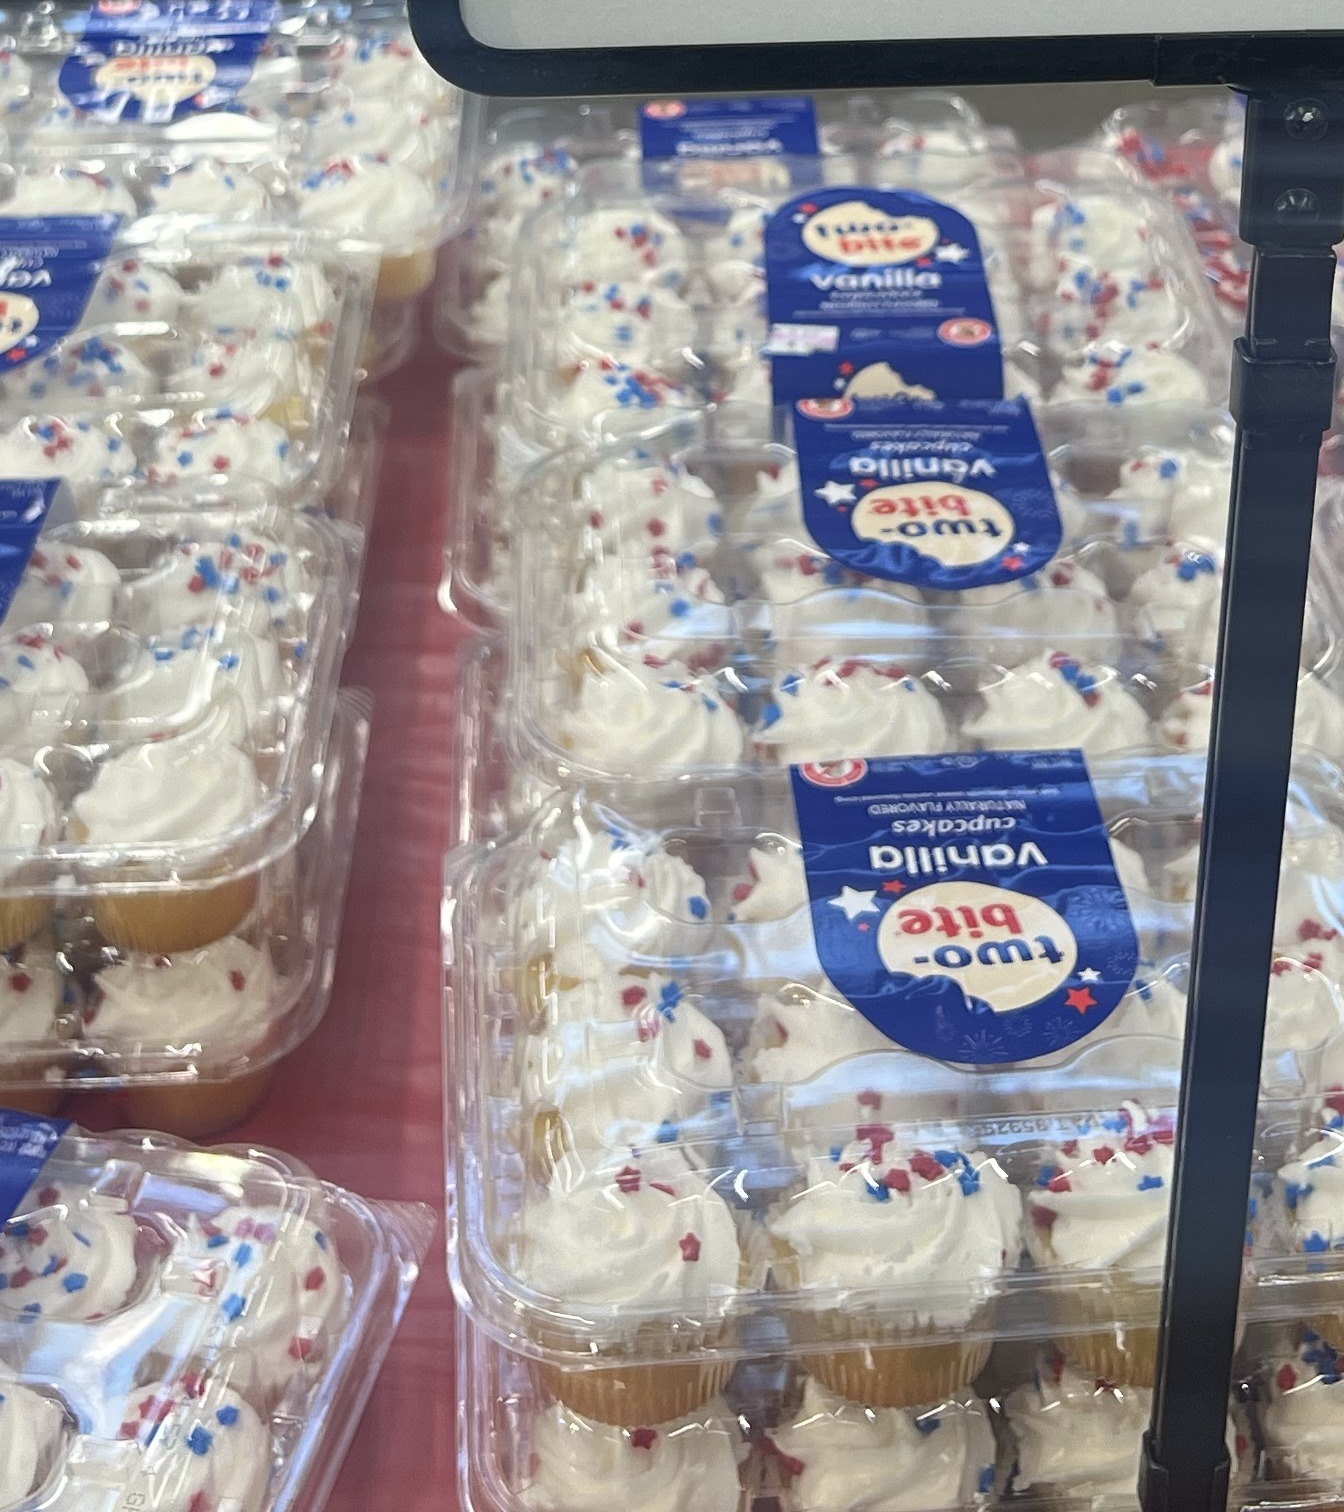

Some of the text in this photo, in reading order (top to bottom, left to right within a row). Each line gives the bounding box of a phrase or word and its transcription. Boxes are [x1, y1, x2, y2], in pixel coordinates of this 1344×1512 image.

[809, 267, 943, 291] vanilla
[849, 455, 997, 481] vanilla
[870, 496, 974, 521] bite
[881, 516, 1005, 540] two-
[867, 799, 1026, 816] NATURALLY FLAVORED
[891, 815, 1017, 838] cupcakes
[869, 841, 1049, 877] vanilla
[899, 902, 1023, 939] bite
[913, 934, 1066, 970] two-
